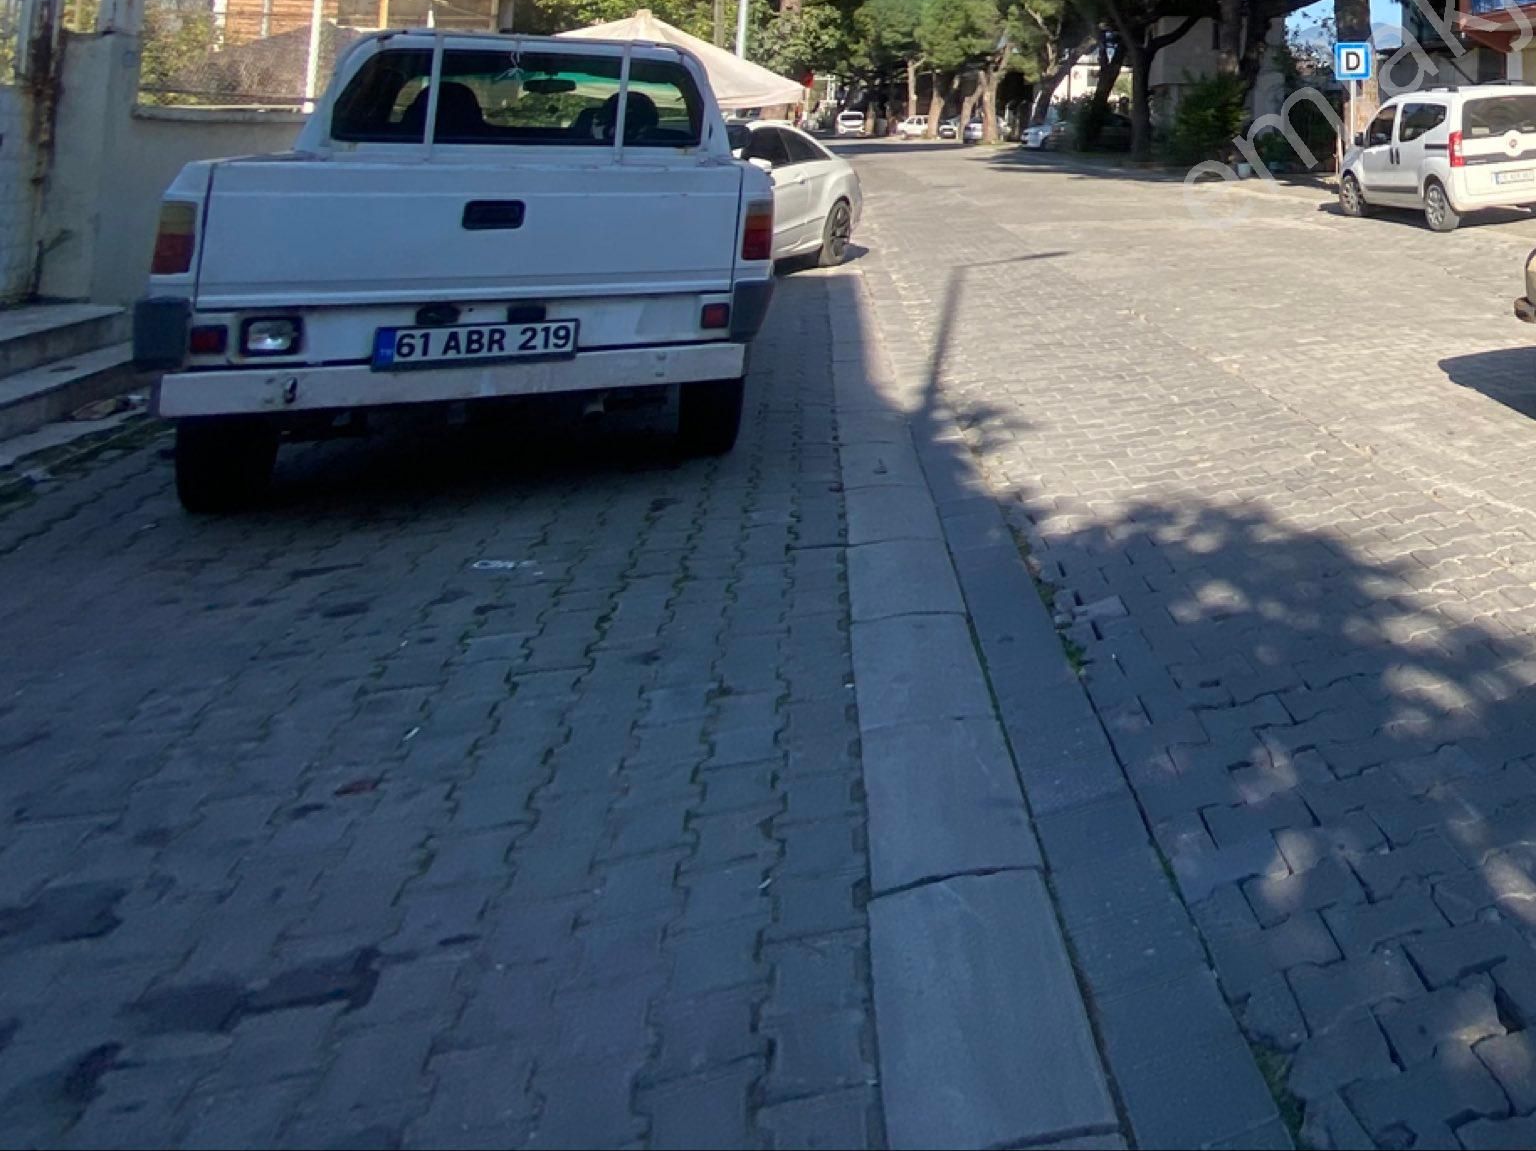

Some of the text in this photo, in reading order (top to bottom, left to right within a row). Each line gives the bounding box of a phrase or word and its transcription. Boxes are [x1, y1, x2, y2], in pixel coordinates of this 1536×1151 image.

[1345, 51, 1361, 71] D
[396, 324, 572, 358] 61 ABR 219
